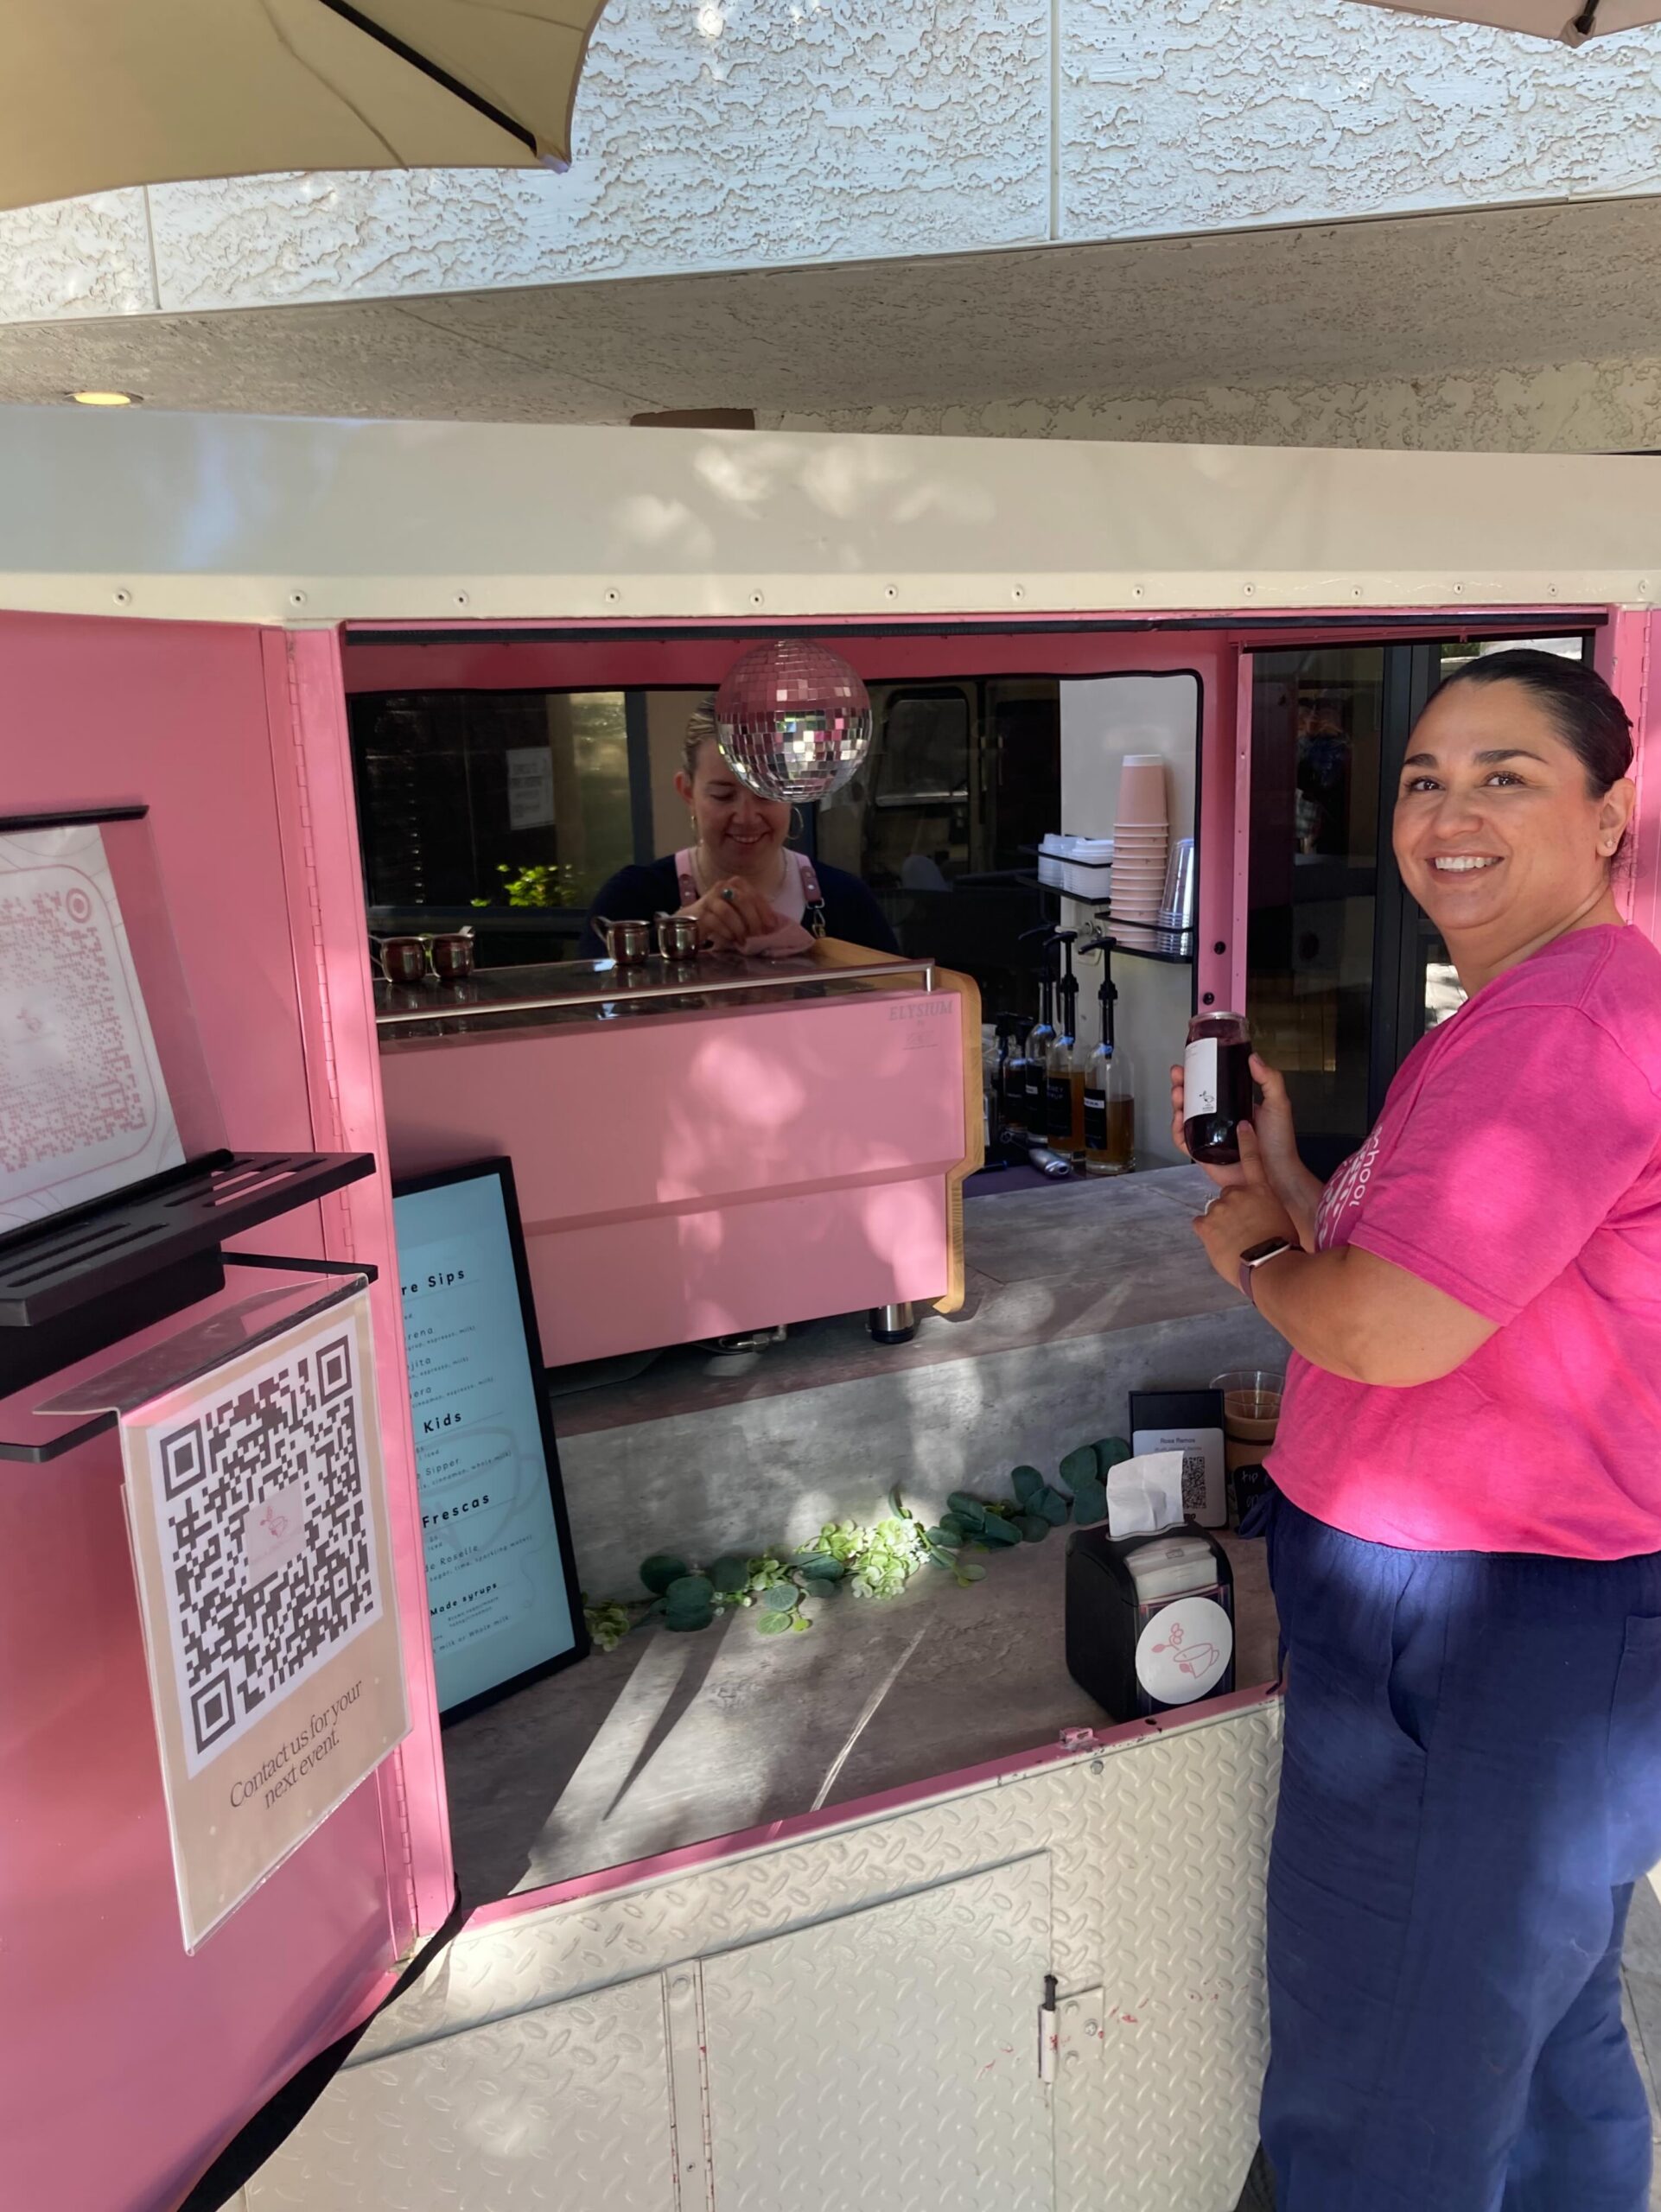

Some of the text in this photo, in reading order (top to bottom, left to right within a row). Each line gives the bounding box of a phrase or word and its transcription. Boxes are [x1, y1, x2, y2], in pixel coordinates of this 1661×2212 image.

[888, 1000, 953, 1021] ELYSIUM
[401, 1269, 466, 1296] re Sips
[408, 1326, 434, 1341] rena
[423, 1412, 462, 1433] Kids
[425, 1458, 460, 1476] Sipper
[422, 1494, 491, 1529] Frescas
[429, 1599, 458, 1616] Made
[461, 1582, 498, 1603] syrups
[230, 1680, 362, 1809] Contact us for your
[264, 1727, 340, 1809] next event.
